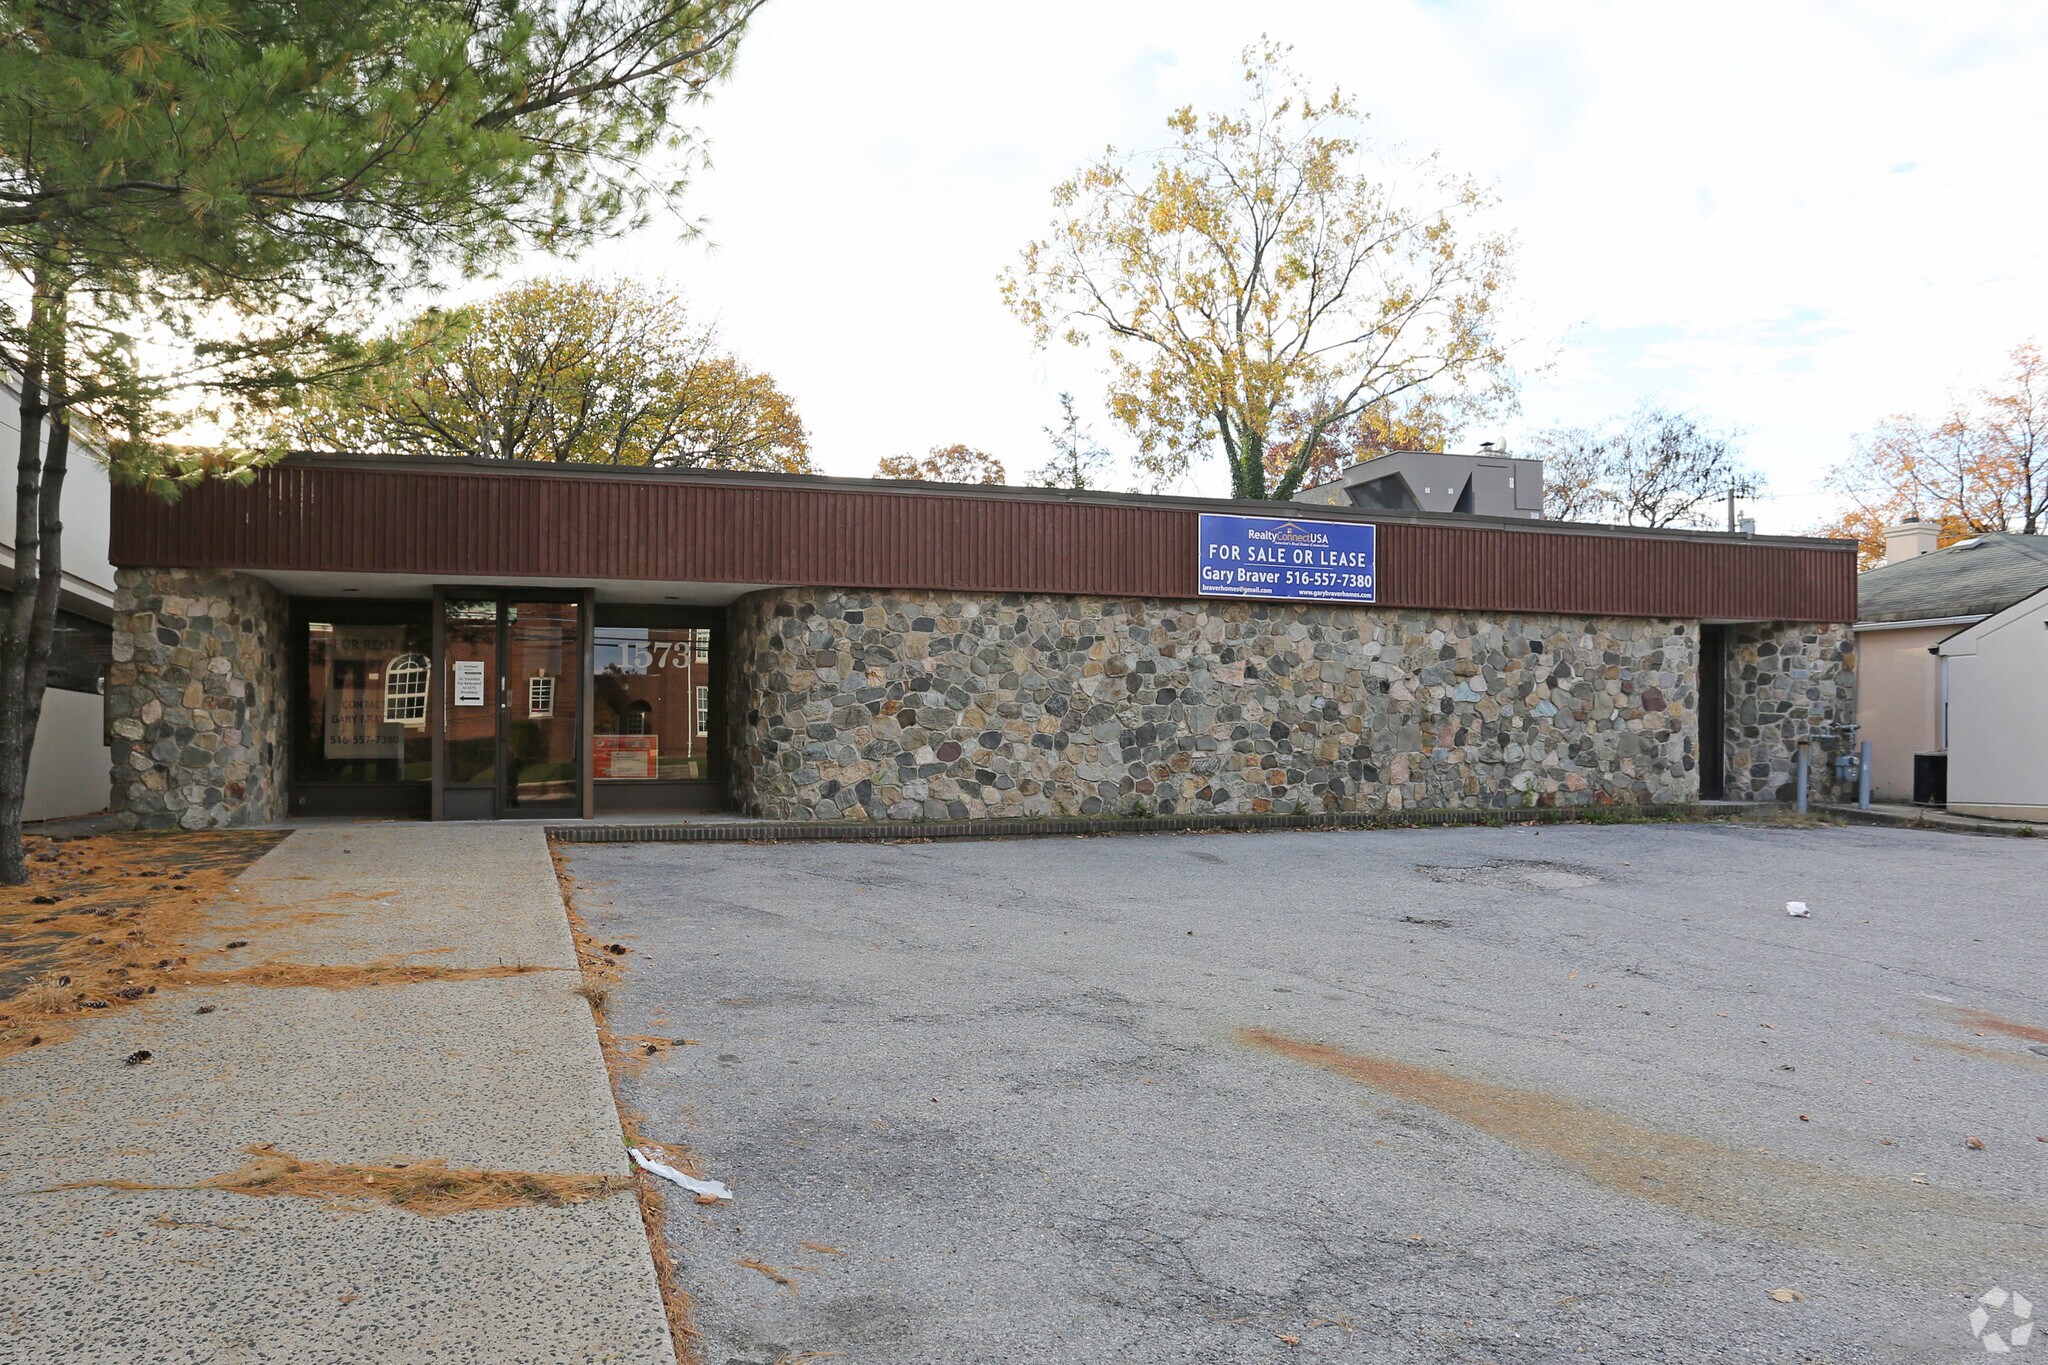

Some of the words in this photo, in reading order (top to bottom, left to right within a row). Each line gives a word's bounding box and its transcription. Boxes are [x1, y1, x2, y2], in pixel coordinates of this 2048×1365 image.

[1248, 530, 1328, 544] RealtyConnectUSA
[1209, 544, 1241, 560] FOR
[1247, 546, 1286, 563] SALE
[1293, 548, 1314, 565] OR
[1320, 550, 1366, 568] LEASE
[1202, 565, 1234, 585] Gary
[1237, 567, 1279, 584] Braver
[1286, 570, 1372, 588] 516-557-7380
[1202, 584, 1272, 594] braverhomes@gmail.com
[1298, 589, 1372, 599] www.garybraverhomes.com
[333, 638, 359, 650] FOR
[363, 638, 397, 650] RENT
[617, 641, 691, 669] 1573
[331, 714, 358, 724] GARY
[329, 735, 400, 745] 516-557-7380
